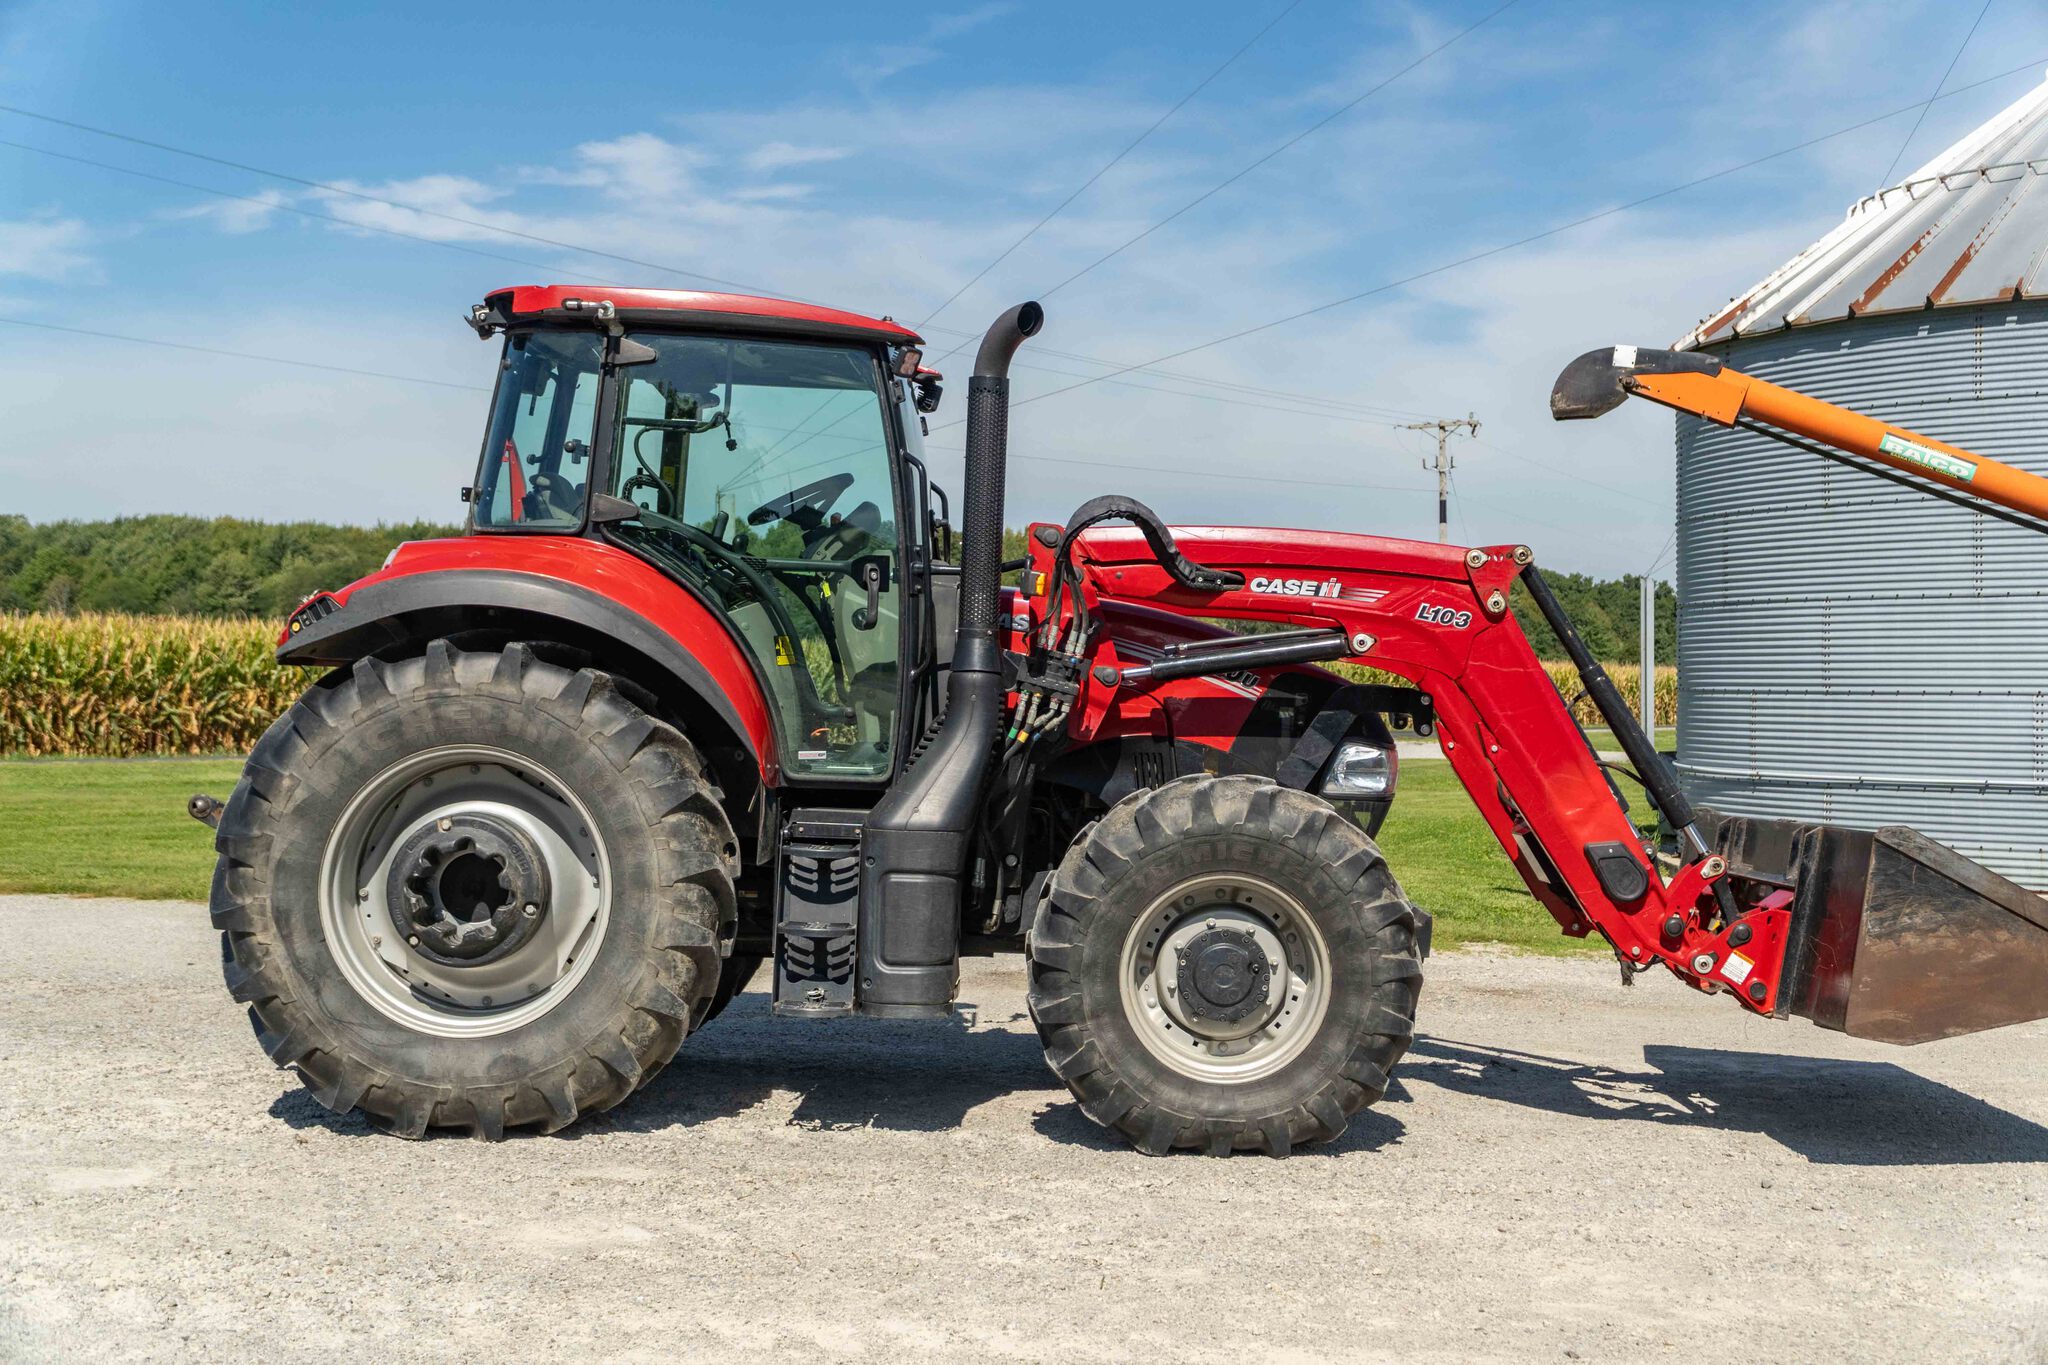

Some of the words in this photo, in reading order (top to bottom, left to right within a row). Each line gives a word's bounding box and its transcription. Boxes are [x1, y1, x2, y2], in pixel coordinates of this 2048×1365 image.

[1885, 435, 1973, 477] BATCO
[1250, 577, 1318, 597] CASE
[1414, 603, 1473, 629] L103
